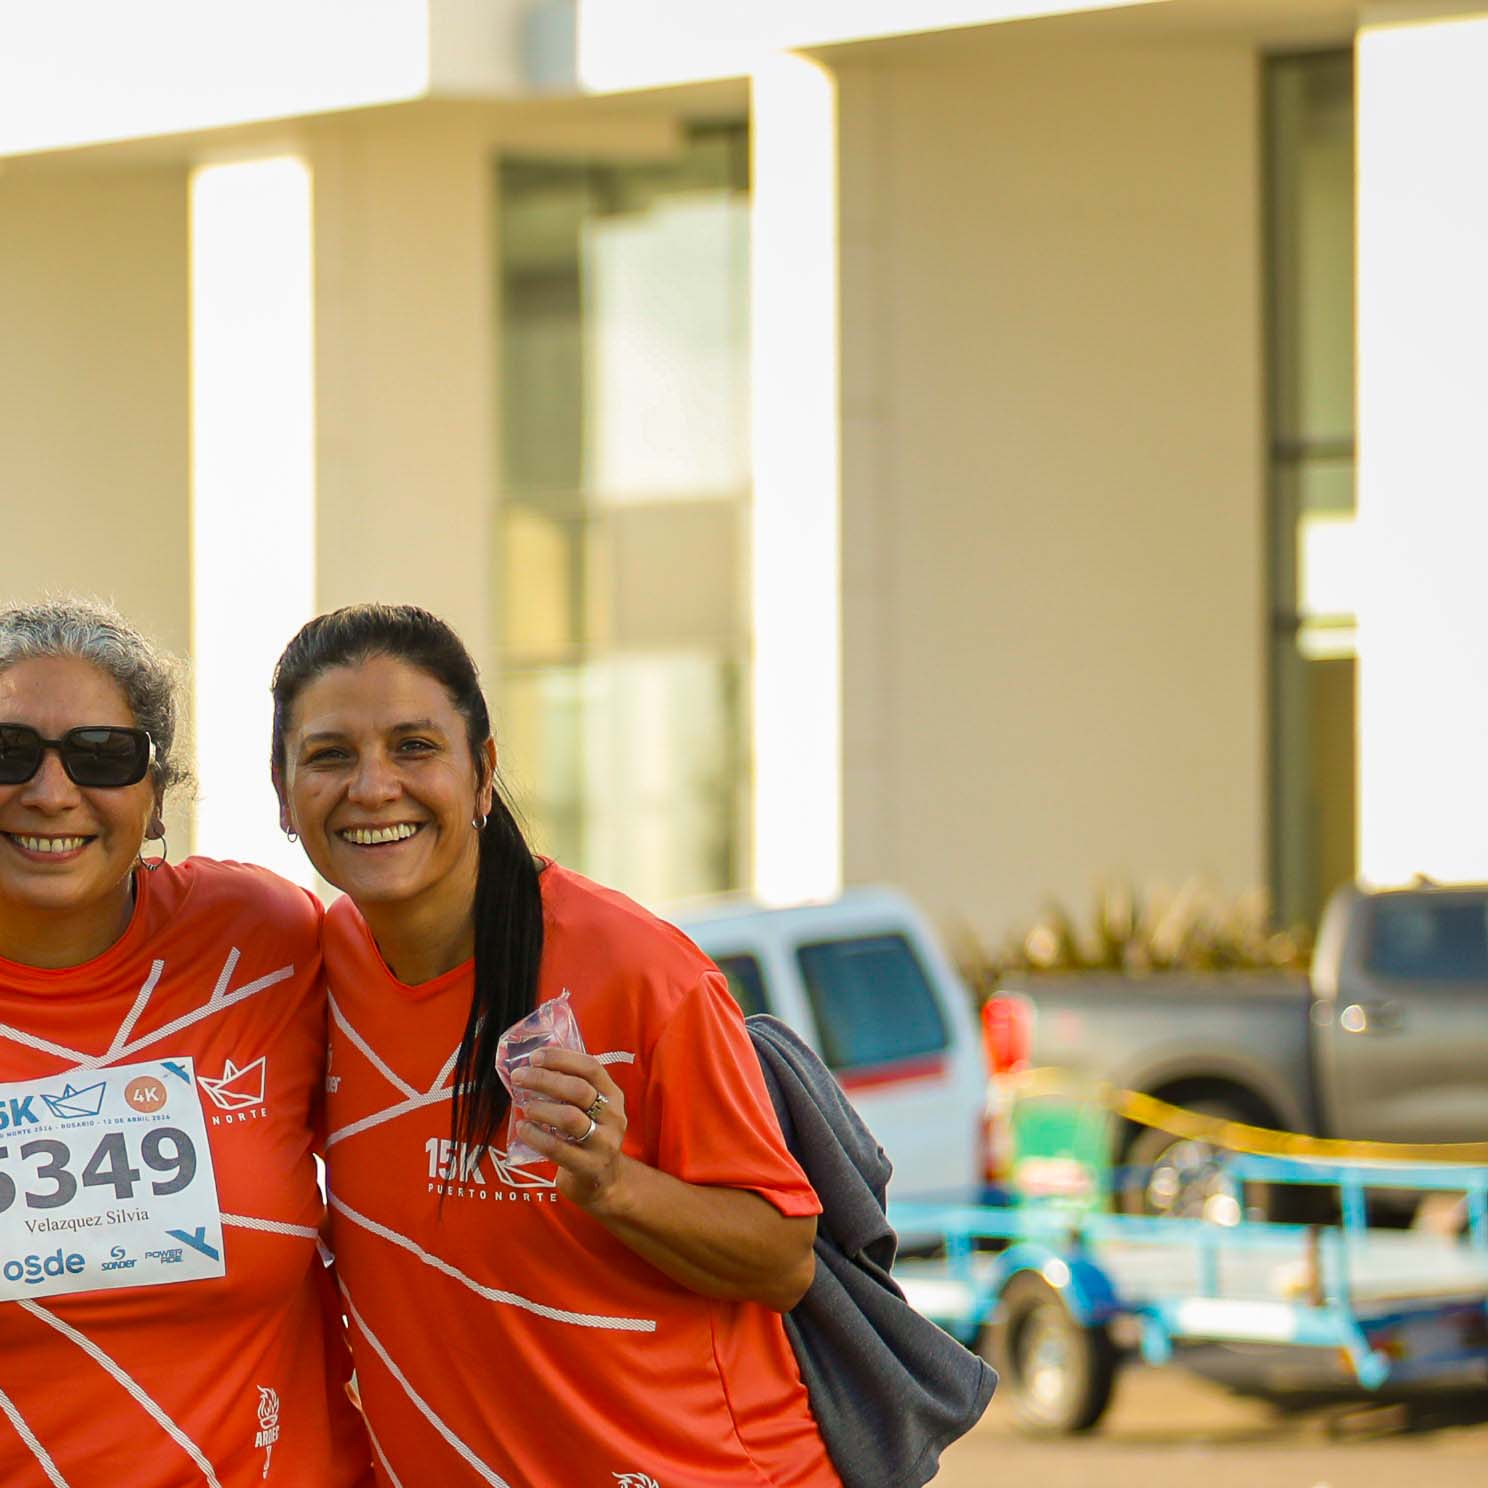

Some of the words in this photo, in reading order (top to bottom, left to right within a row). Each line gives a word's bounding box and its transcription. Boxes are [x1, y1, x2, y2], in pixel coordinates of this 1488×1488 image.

[132, 1087, 160, 1103] 4K
[212, 1108, 268, 1126] NORTE
[425, 1137, 486, 1184] 15K
[428, 1183, 486, 1200] PUERTO
[494, 1191, 558, 1202] NORTE
[25, 1215, 103, 1233] Velazquez
[106, 1208, 149, 1224] Silvia
[145, 1248, 184, 1260] POWER
[3, 1248, 86, 1284] osde
